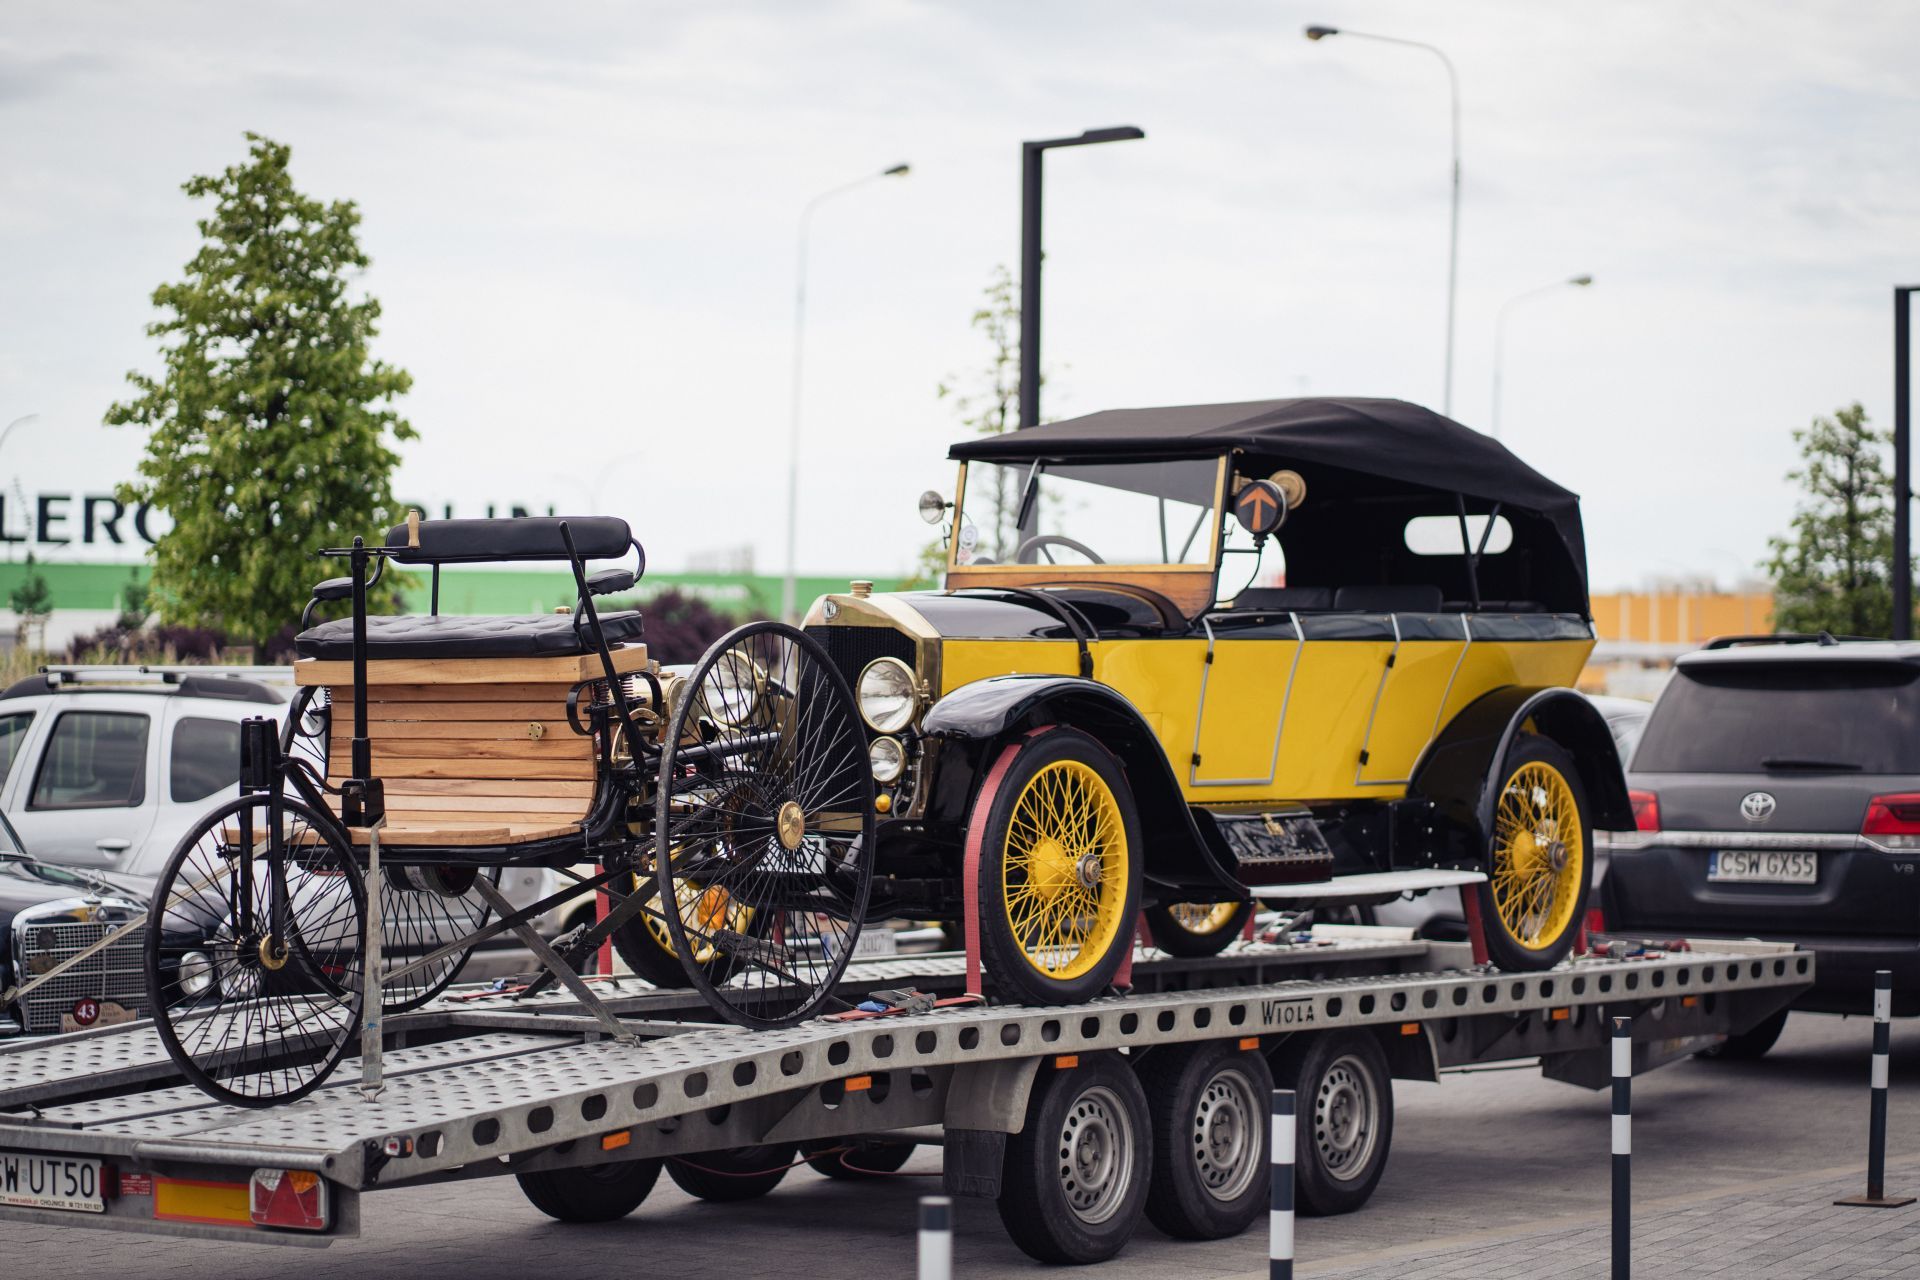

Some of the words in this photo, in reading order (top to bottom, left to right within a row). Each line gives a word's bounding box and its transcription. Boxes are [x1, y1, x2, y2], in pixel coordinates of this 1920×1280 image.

[0, 496, 177, 544] LERO
[1721, 852, 1760, 874] CSW
[1767, 853, 1813, 876] GX55
[1892, 863, 1914, 873] V8
[78, 1004, 95, 1019] 43
[1262, 997, 1314, 1025] WIOLA
[0, 1157, 19, 1192] W
[30, 1159, 94, 1198] UT50
